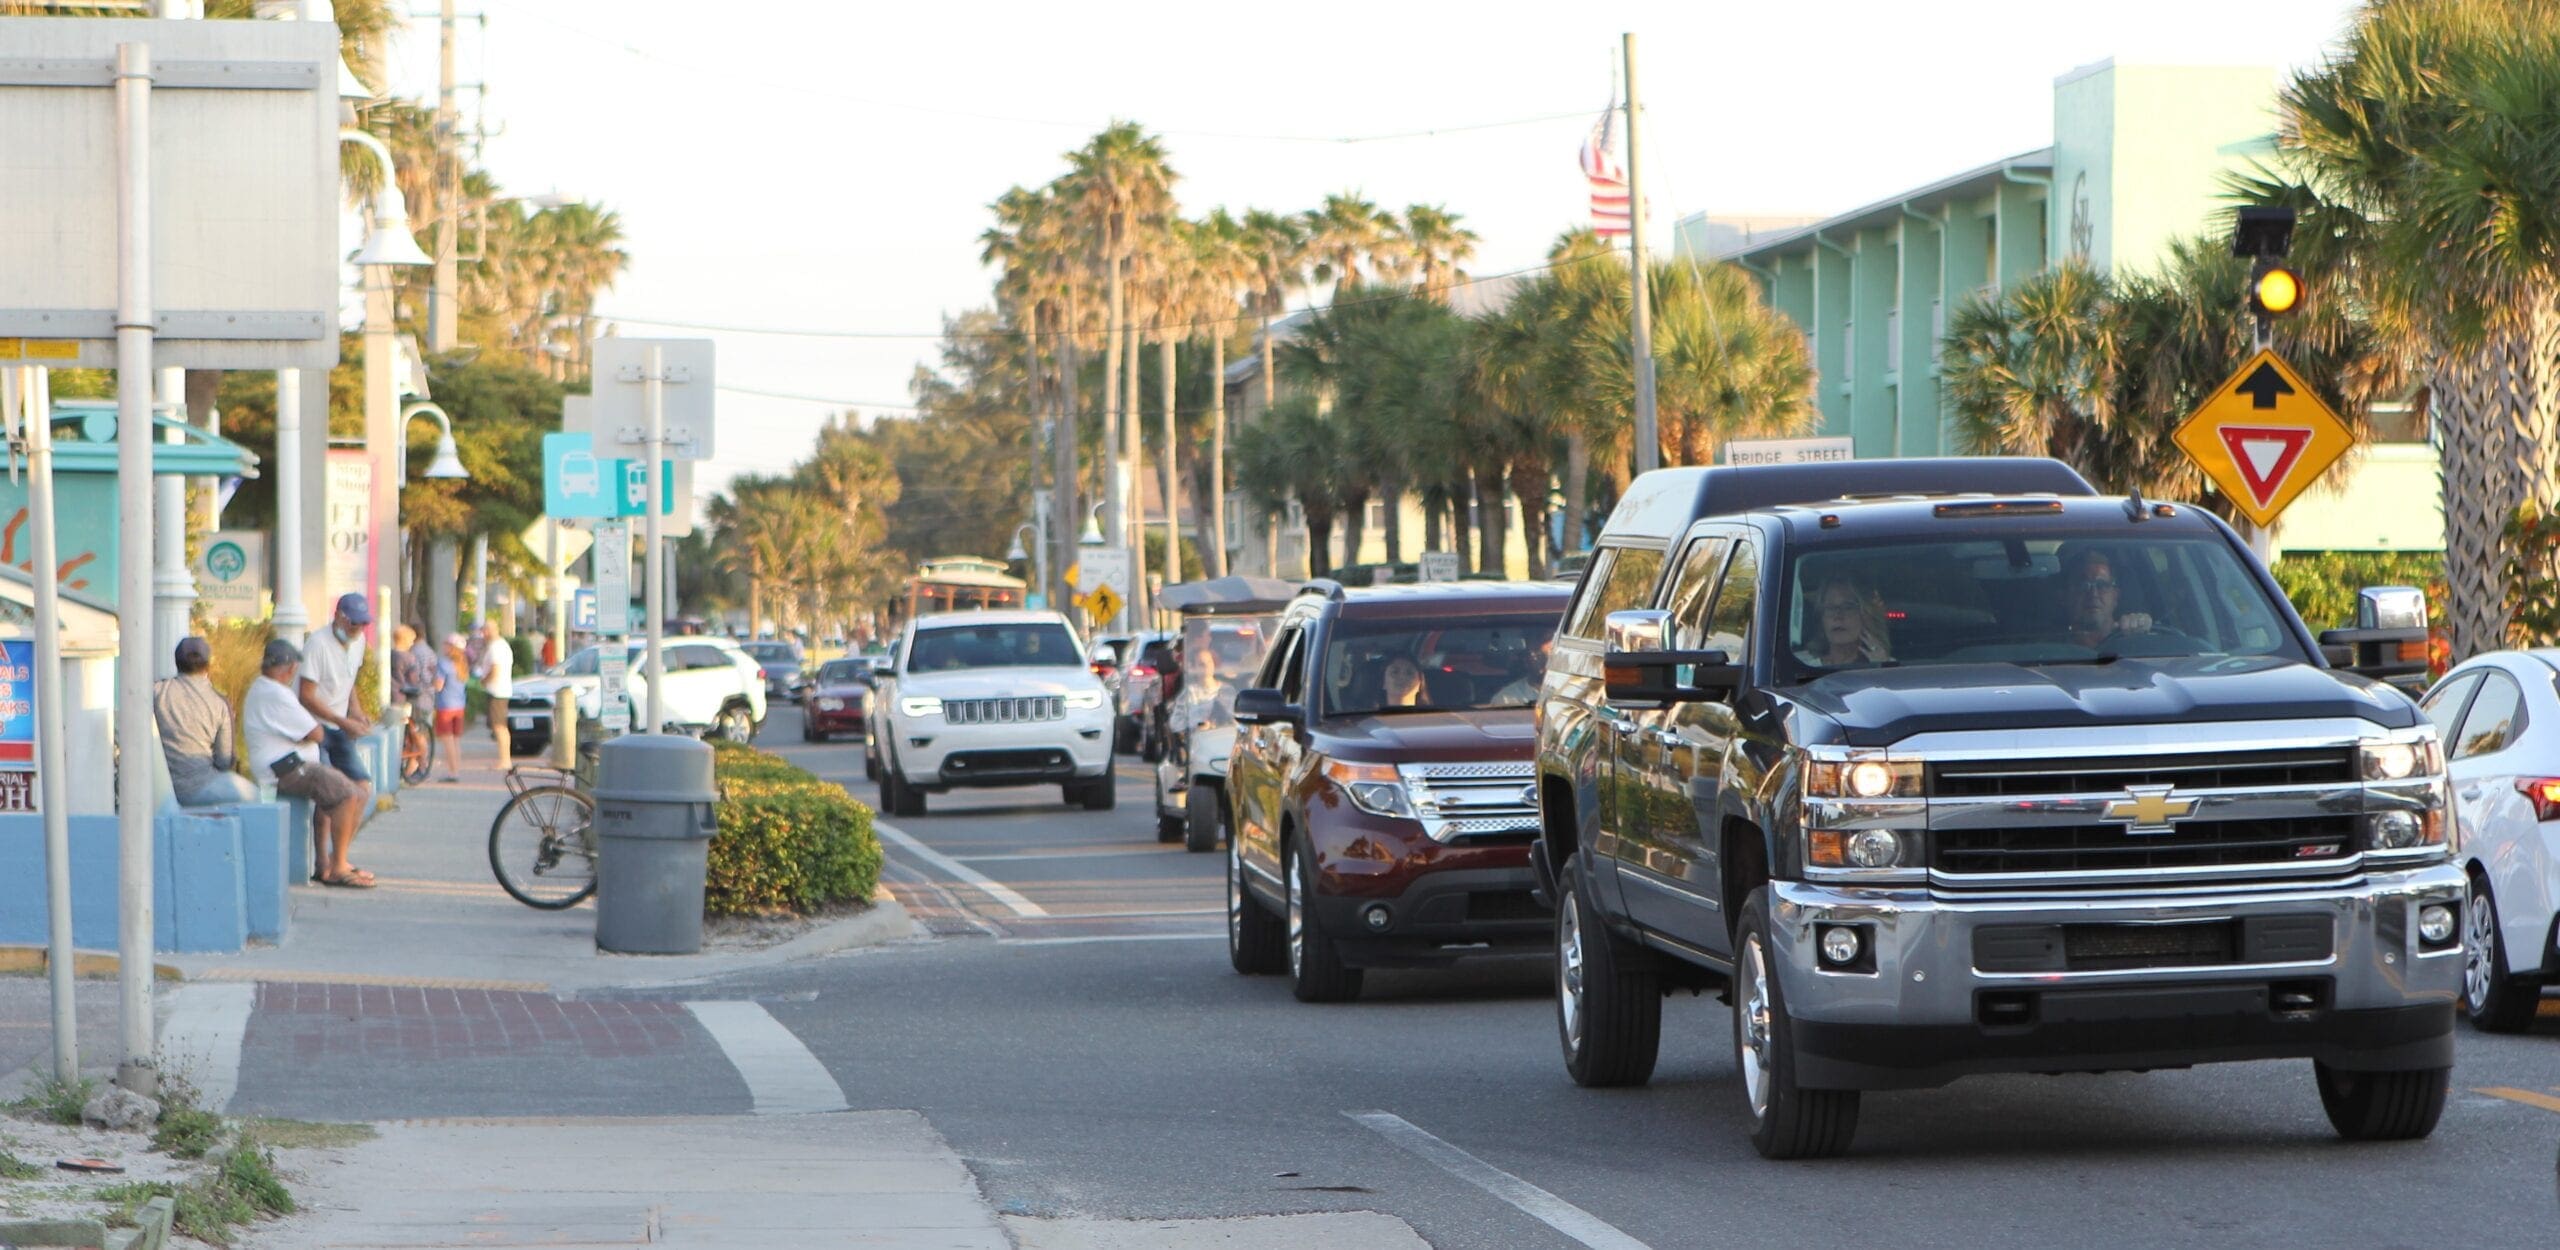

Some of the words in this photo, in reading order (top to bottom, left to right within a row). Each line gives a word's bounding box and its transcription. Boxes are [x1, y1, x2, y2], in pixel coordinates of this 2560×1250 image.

[1732, 452, 1782, 465] BRIDGE
[1797, 449, 1848, 462] STREET
[0, 786, 29, 809] H
